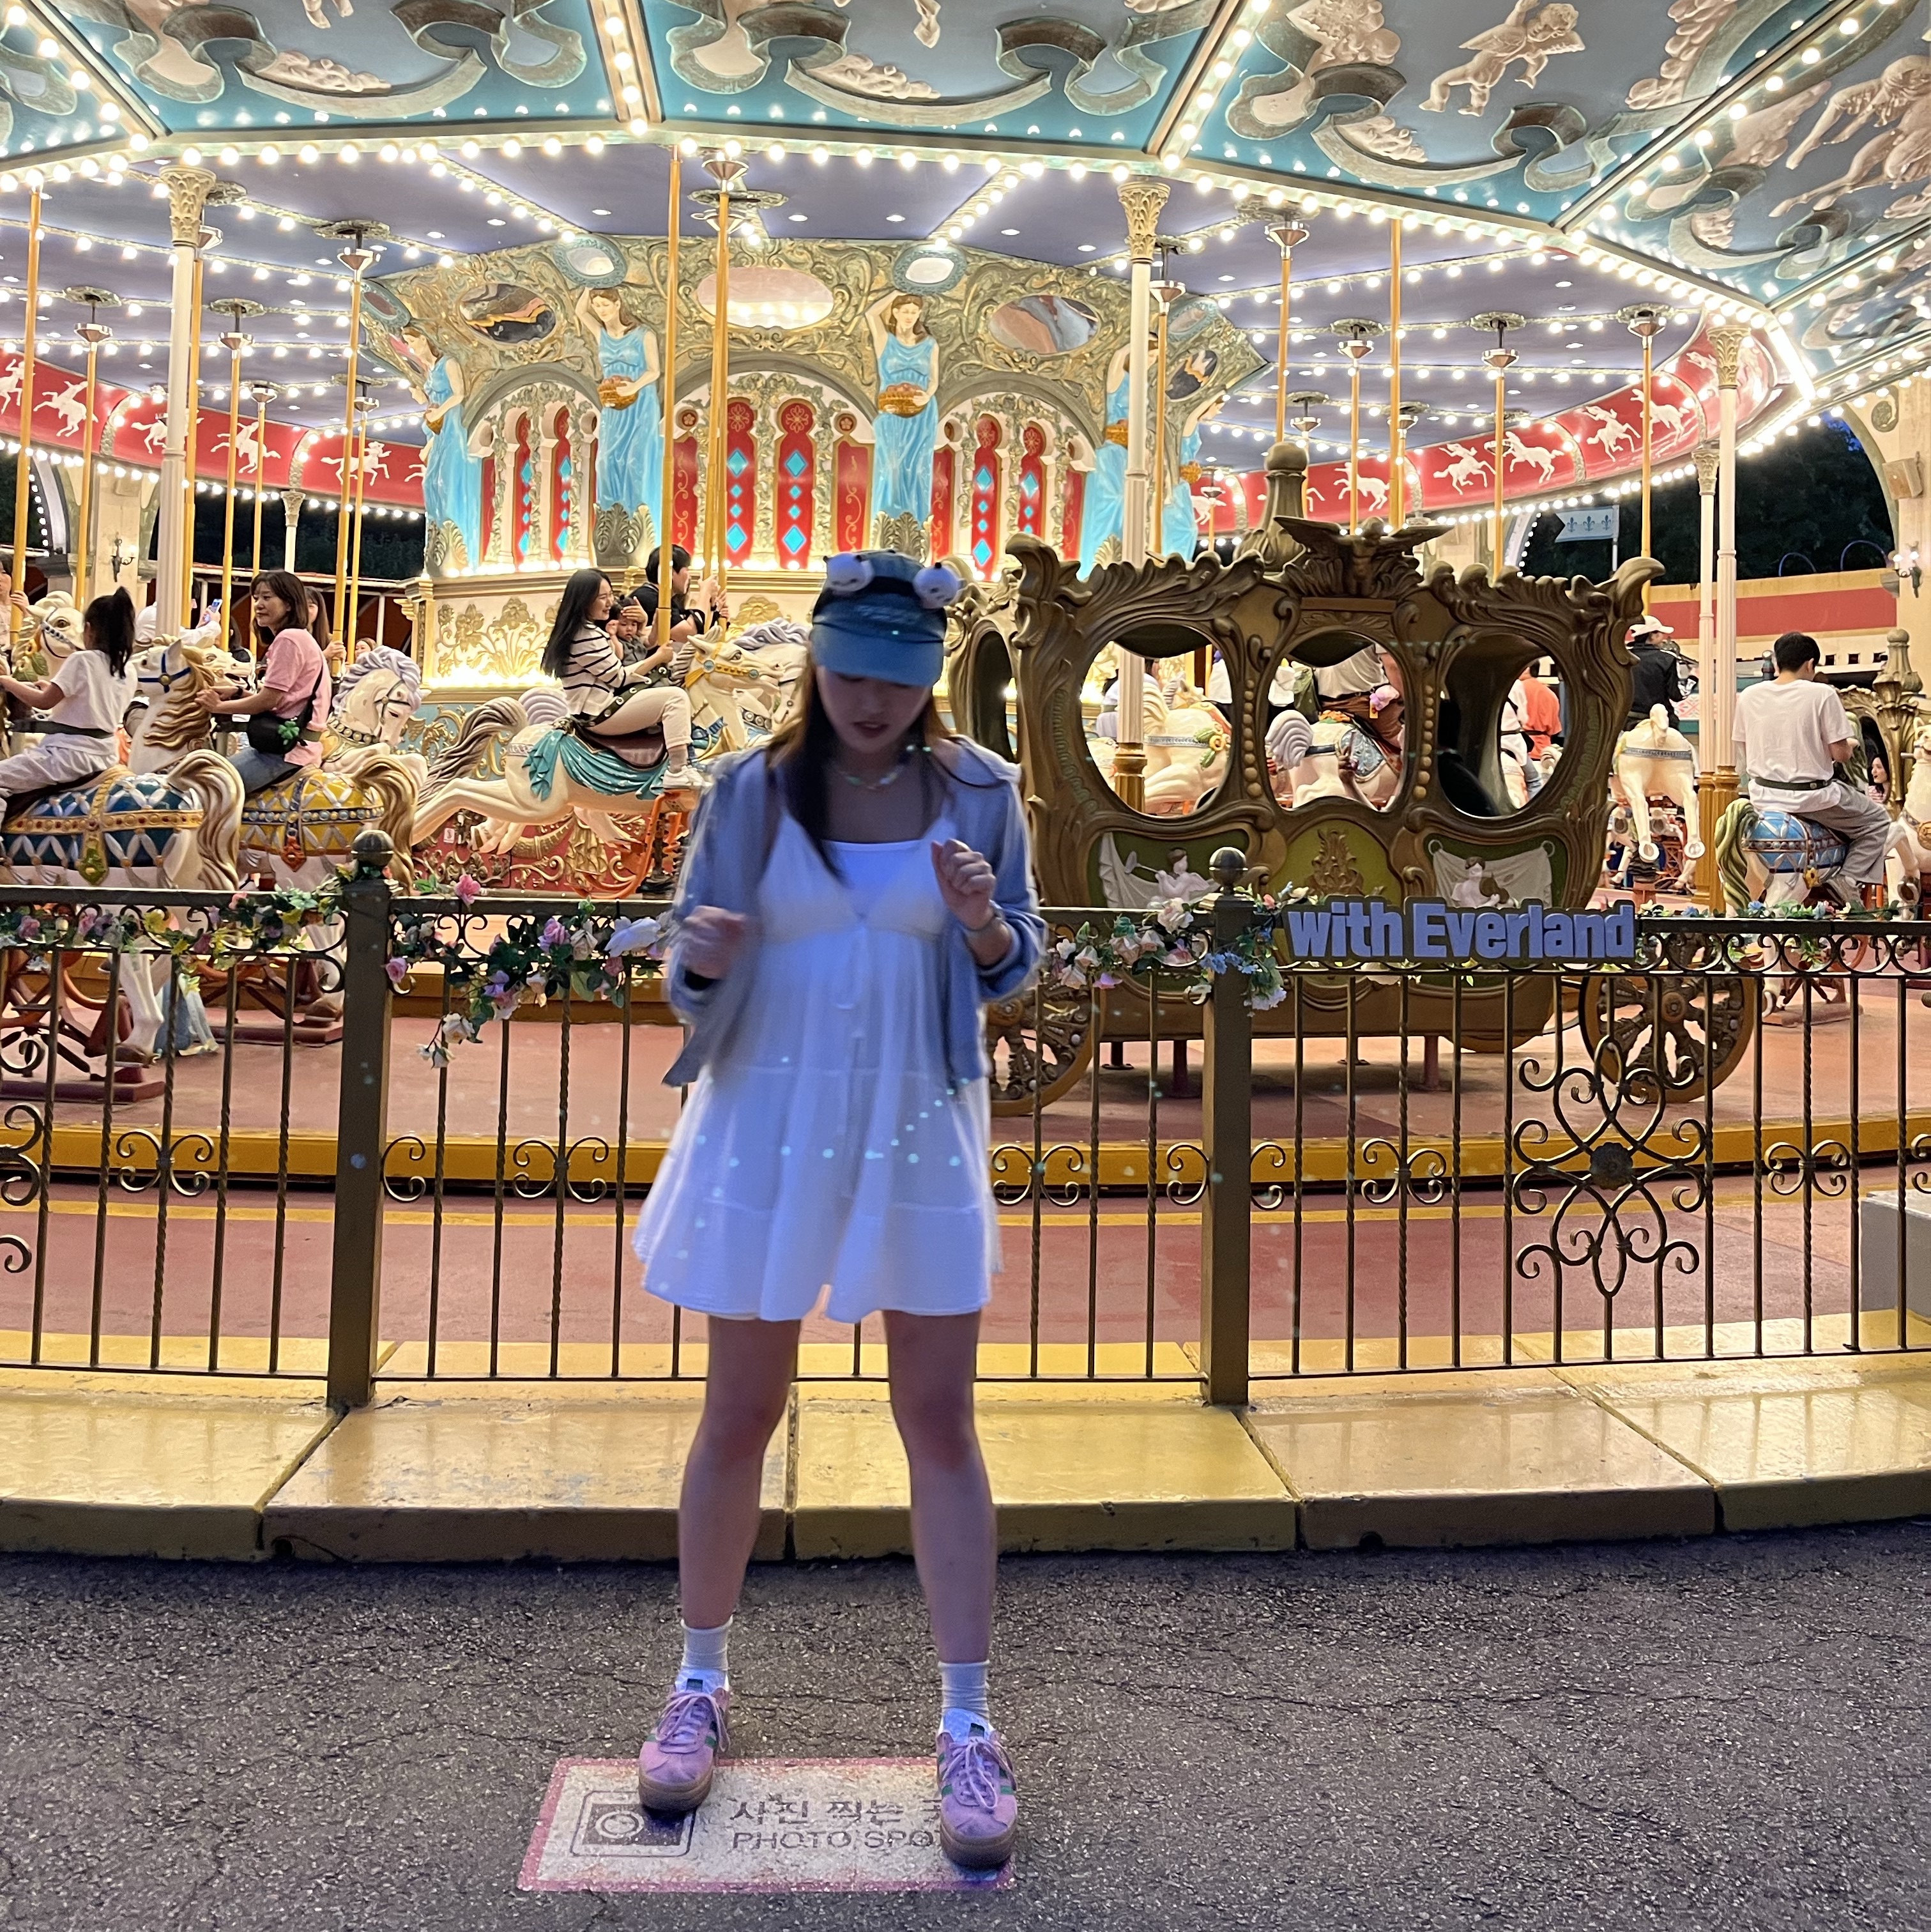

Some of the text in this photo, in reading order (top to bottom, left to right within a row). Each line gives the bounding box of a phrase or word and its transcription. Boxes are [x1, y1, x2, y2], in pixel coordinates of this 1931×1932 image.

[1287, 901, 1635, 959] with Everland
[729, 1798, 809, 1825] 사진
[827, 1798, 904, 1823] 찍는
[732, 1829, 941, 1850] PHOTO SPO
